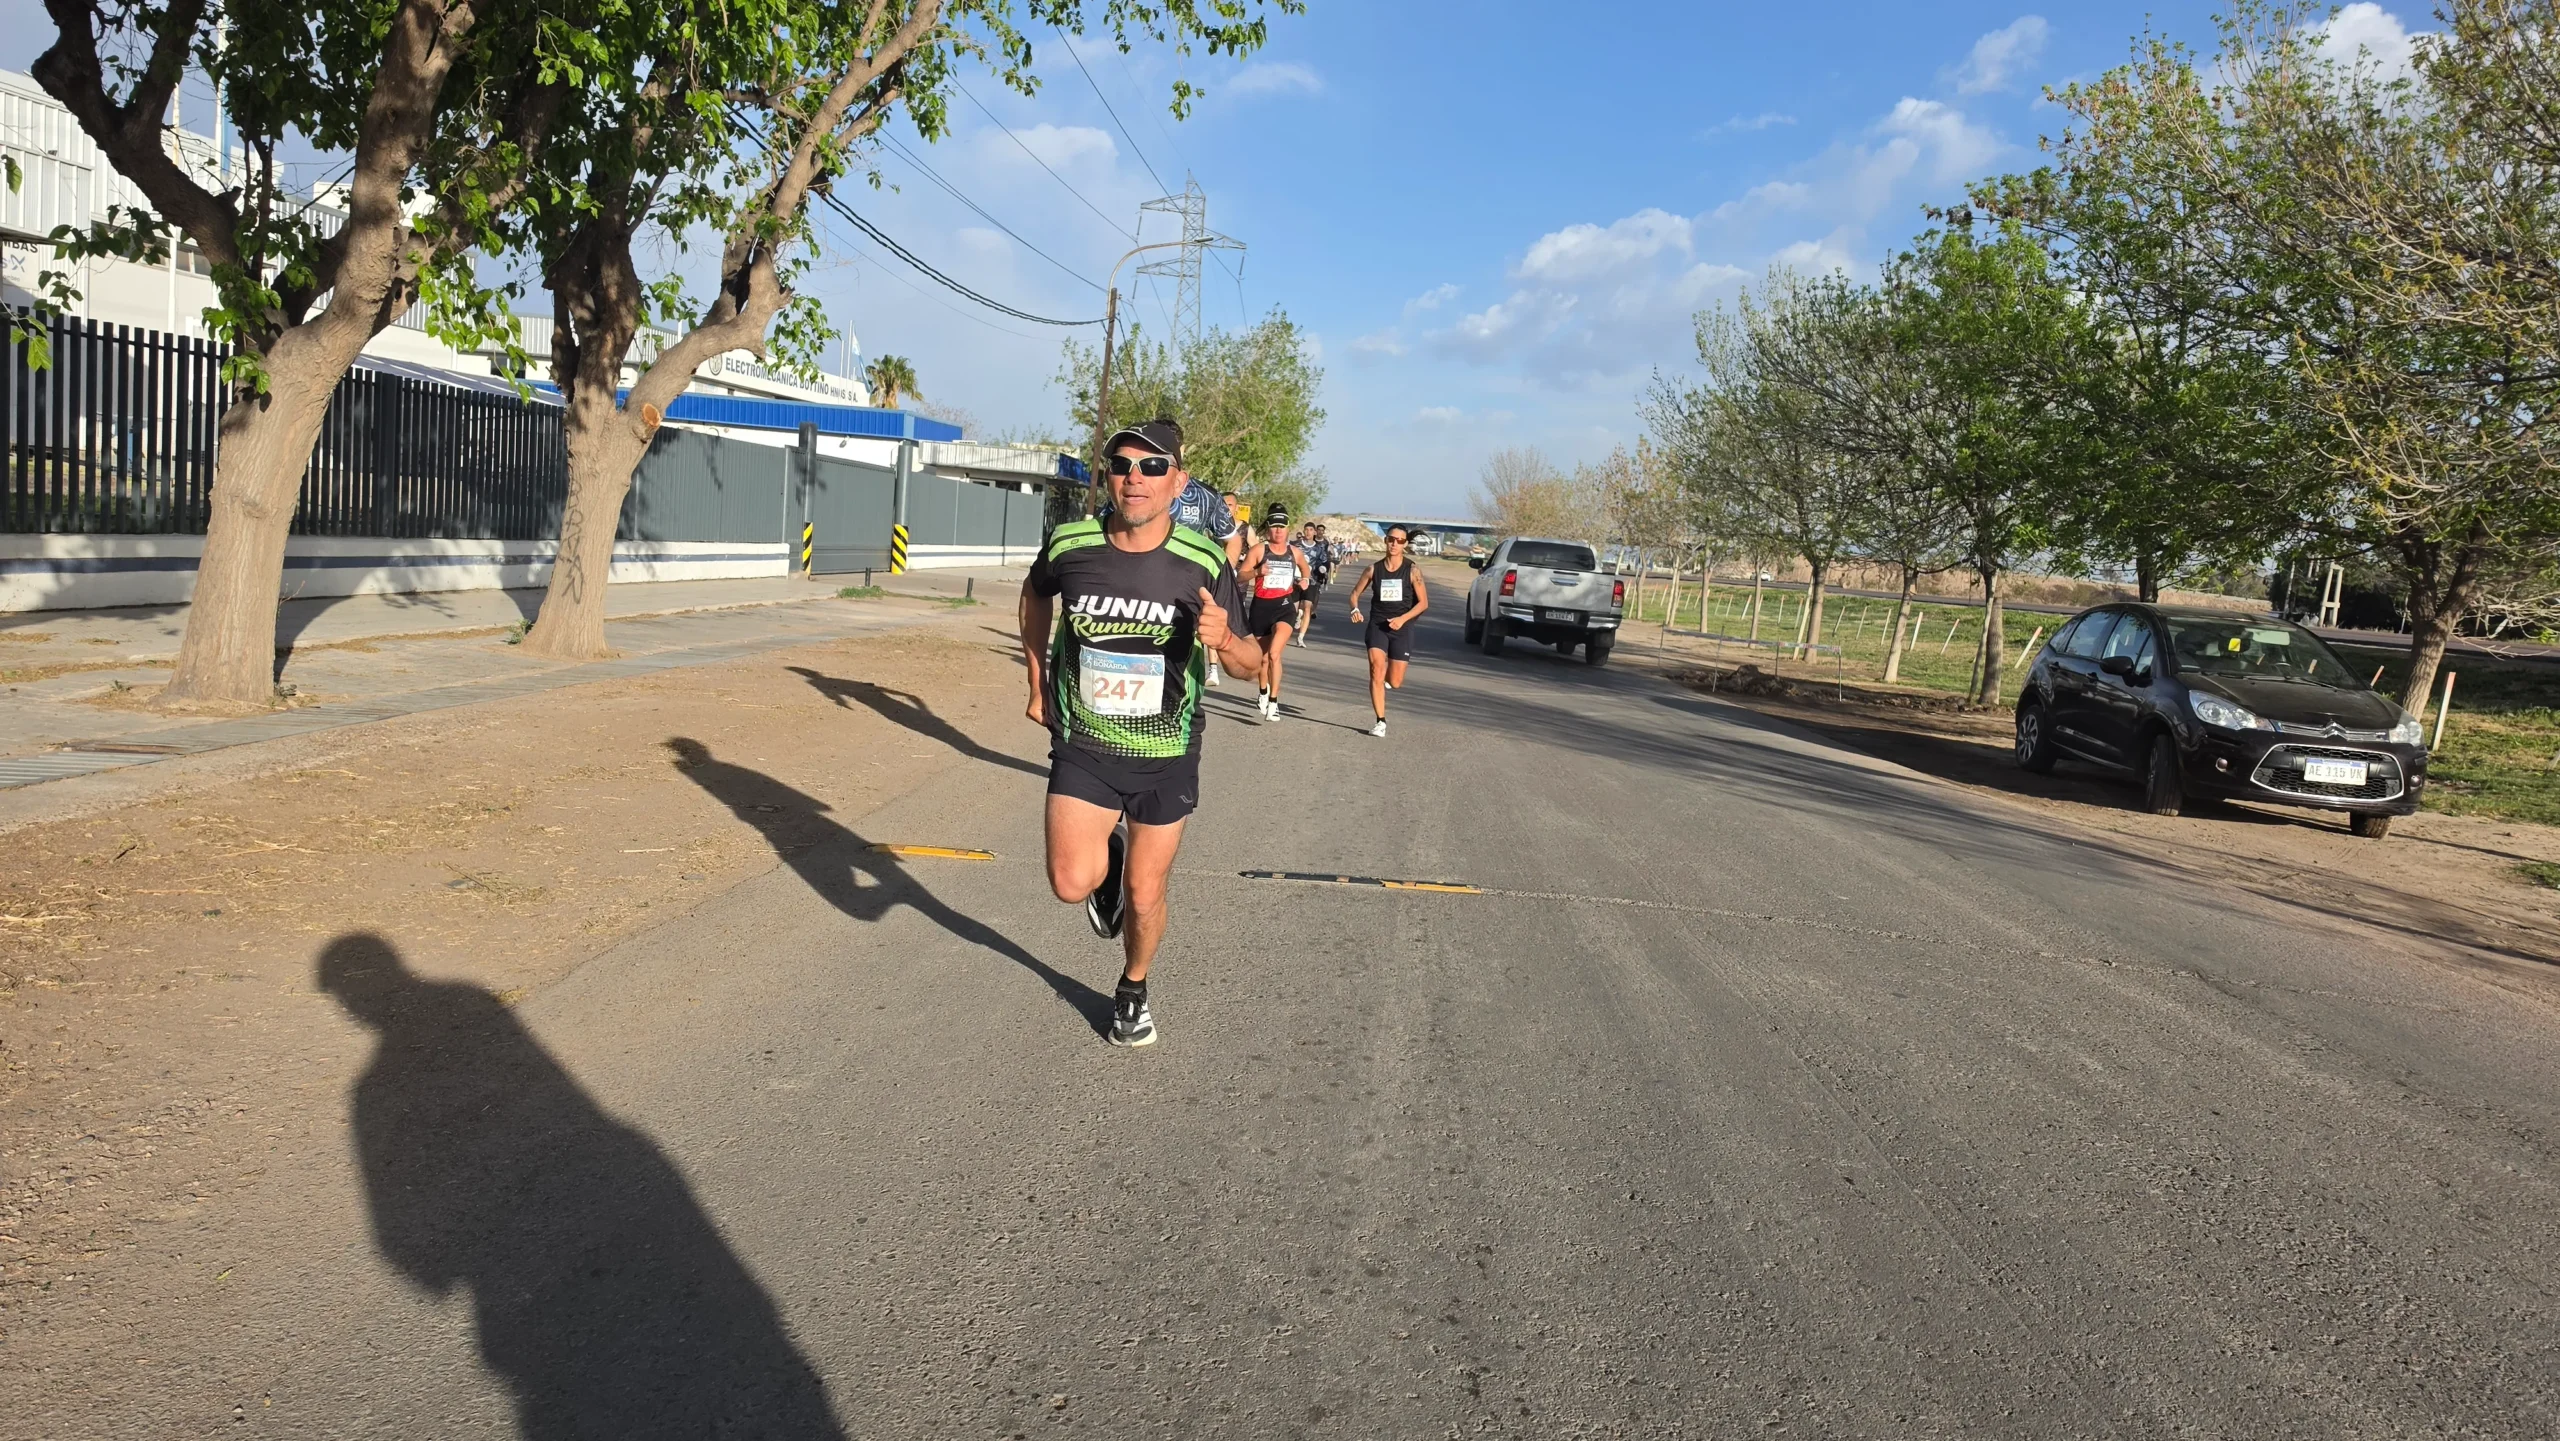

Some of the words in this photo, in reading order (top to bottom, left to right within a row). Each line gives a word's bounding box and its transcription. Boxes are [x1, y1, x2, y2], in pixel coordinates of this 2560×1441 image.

[1382, 589, 1400, 598] 223
[1069, 595, 1176, 624] JUNIN
[1069, 613, 1176, 645] Running
[1093, 660, 1129, 670] BONARDA
[1094, 677, 1145, 700] 247
[2308, 765, 2321, 776] AE
[2325, 766, 2346, 778] 115
[2350, 767, 2364, 779] VK
